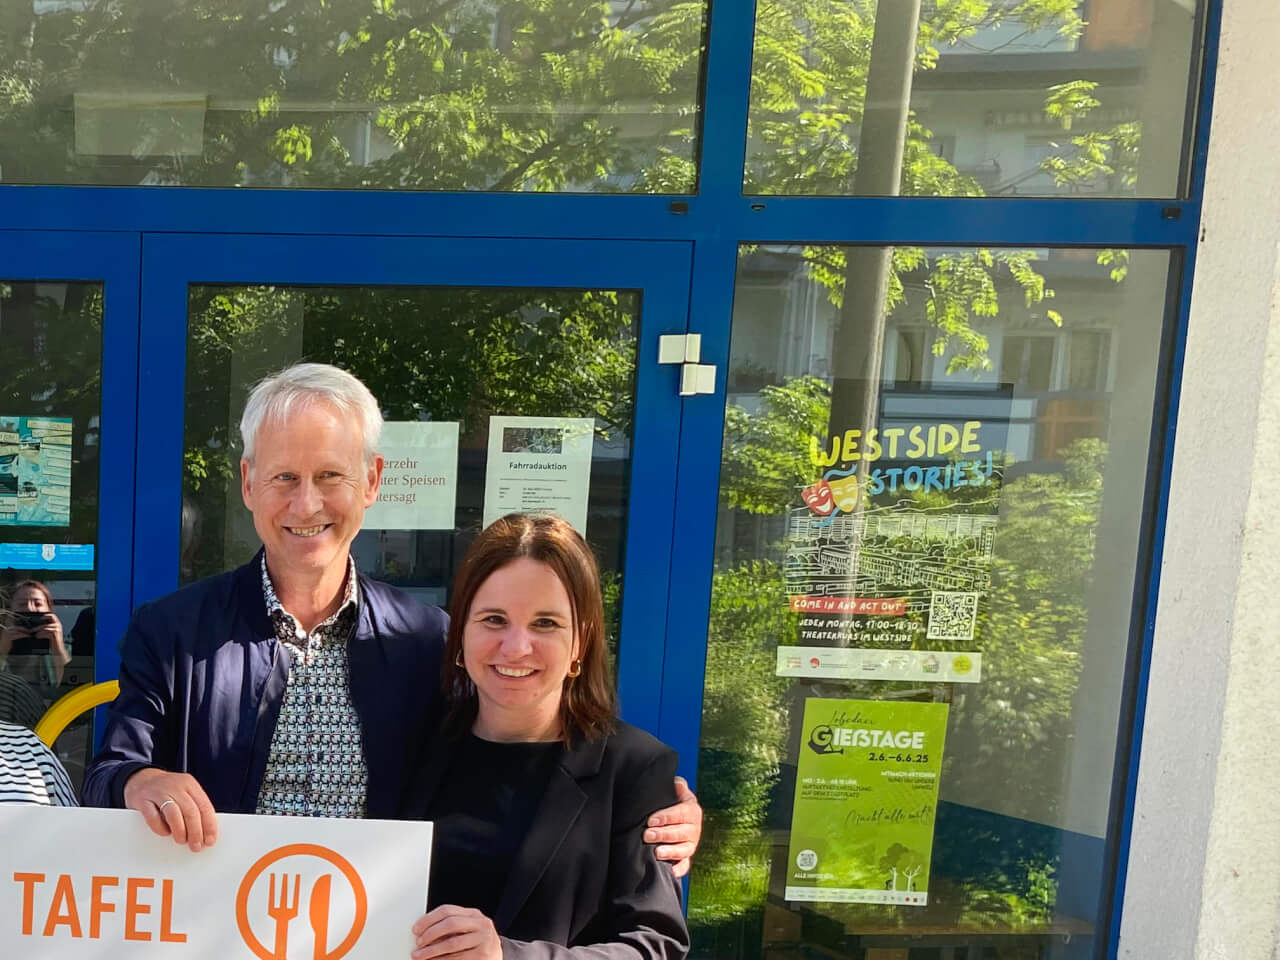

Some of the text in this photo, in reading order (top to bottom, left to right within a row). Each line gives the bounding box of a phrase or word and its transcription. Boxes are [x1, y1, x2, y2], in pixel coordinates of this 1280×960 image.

[809, 421, 982, 467] WESTSIDE
[383, 457, 417, 469] erzehr
[509, 461, 568, 471] Fahrradauktion
[869, 451, 993, 496] STORIES!
[401, 474, 446, 488] Speisen
[794, 600, 822, 609] COME
[13, 871, 188, 944] TAFEL
